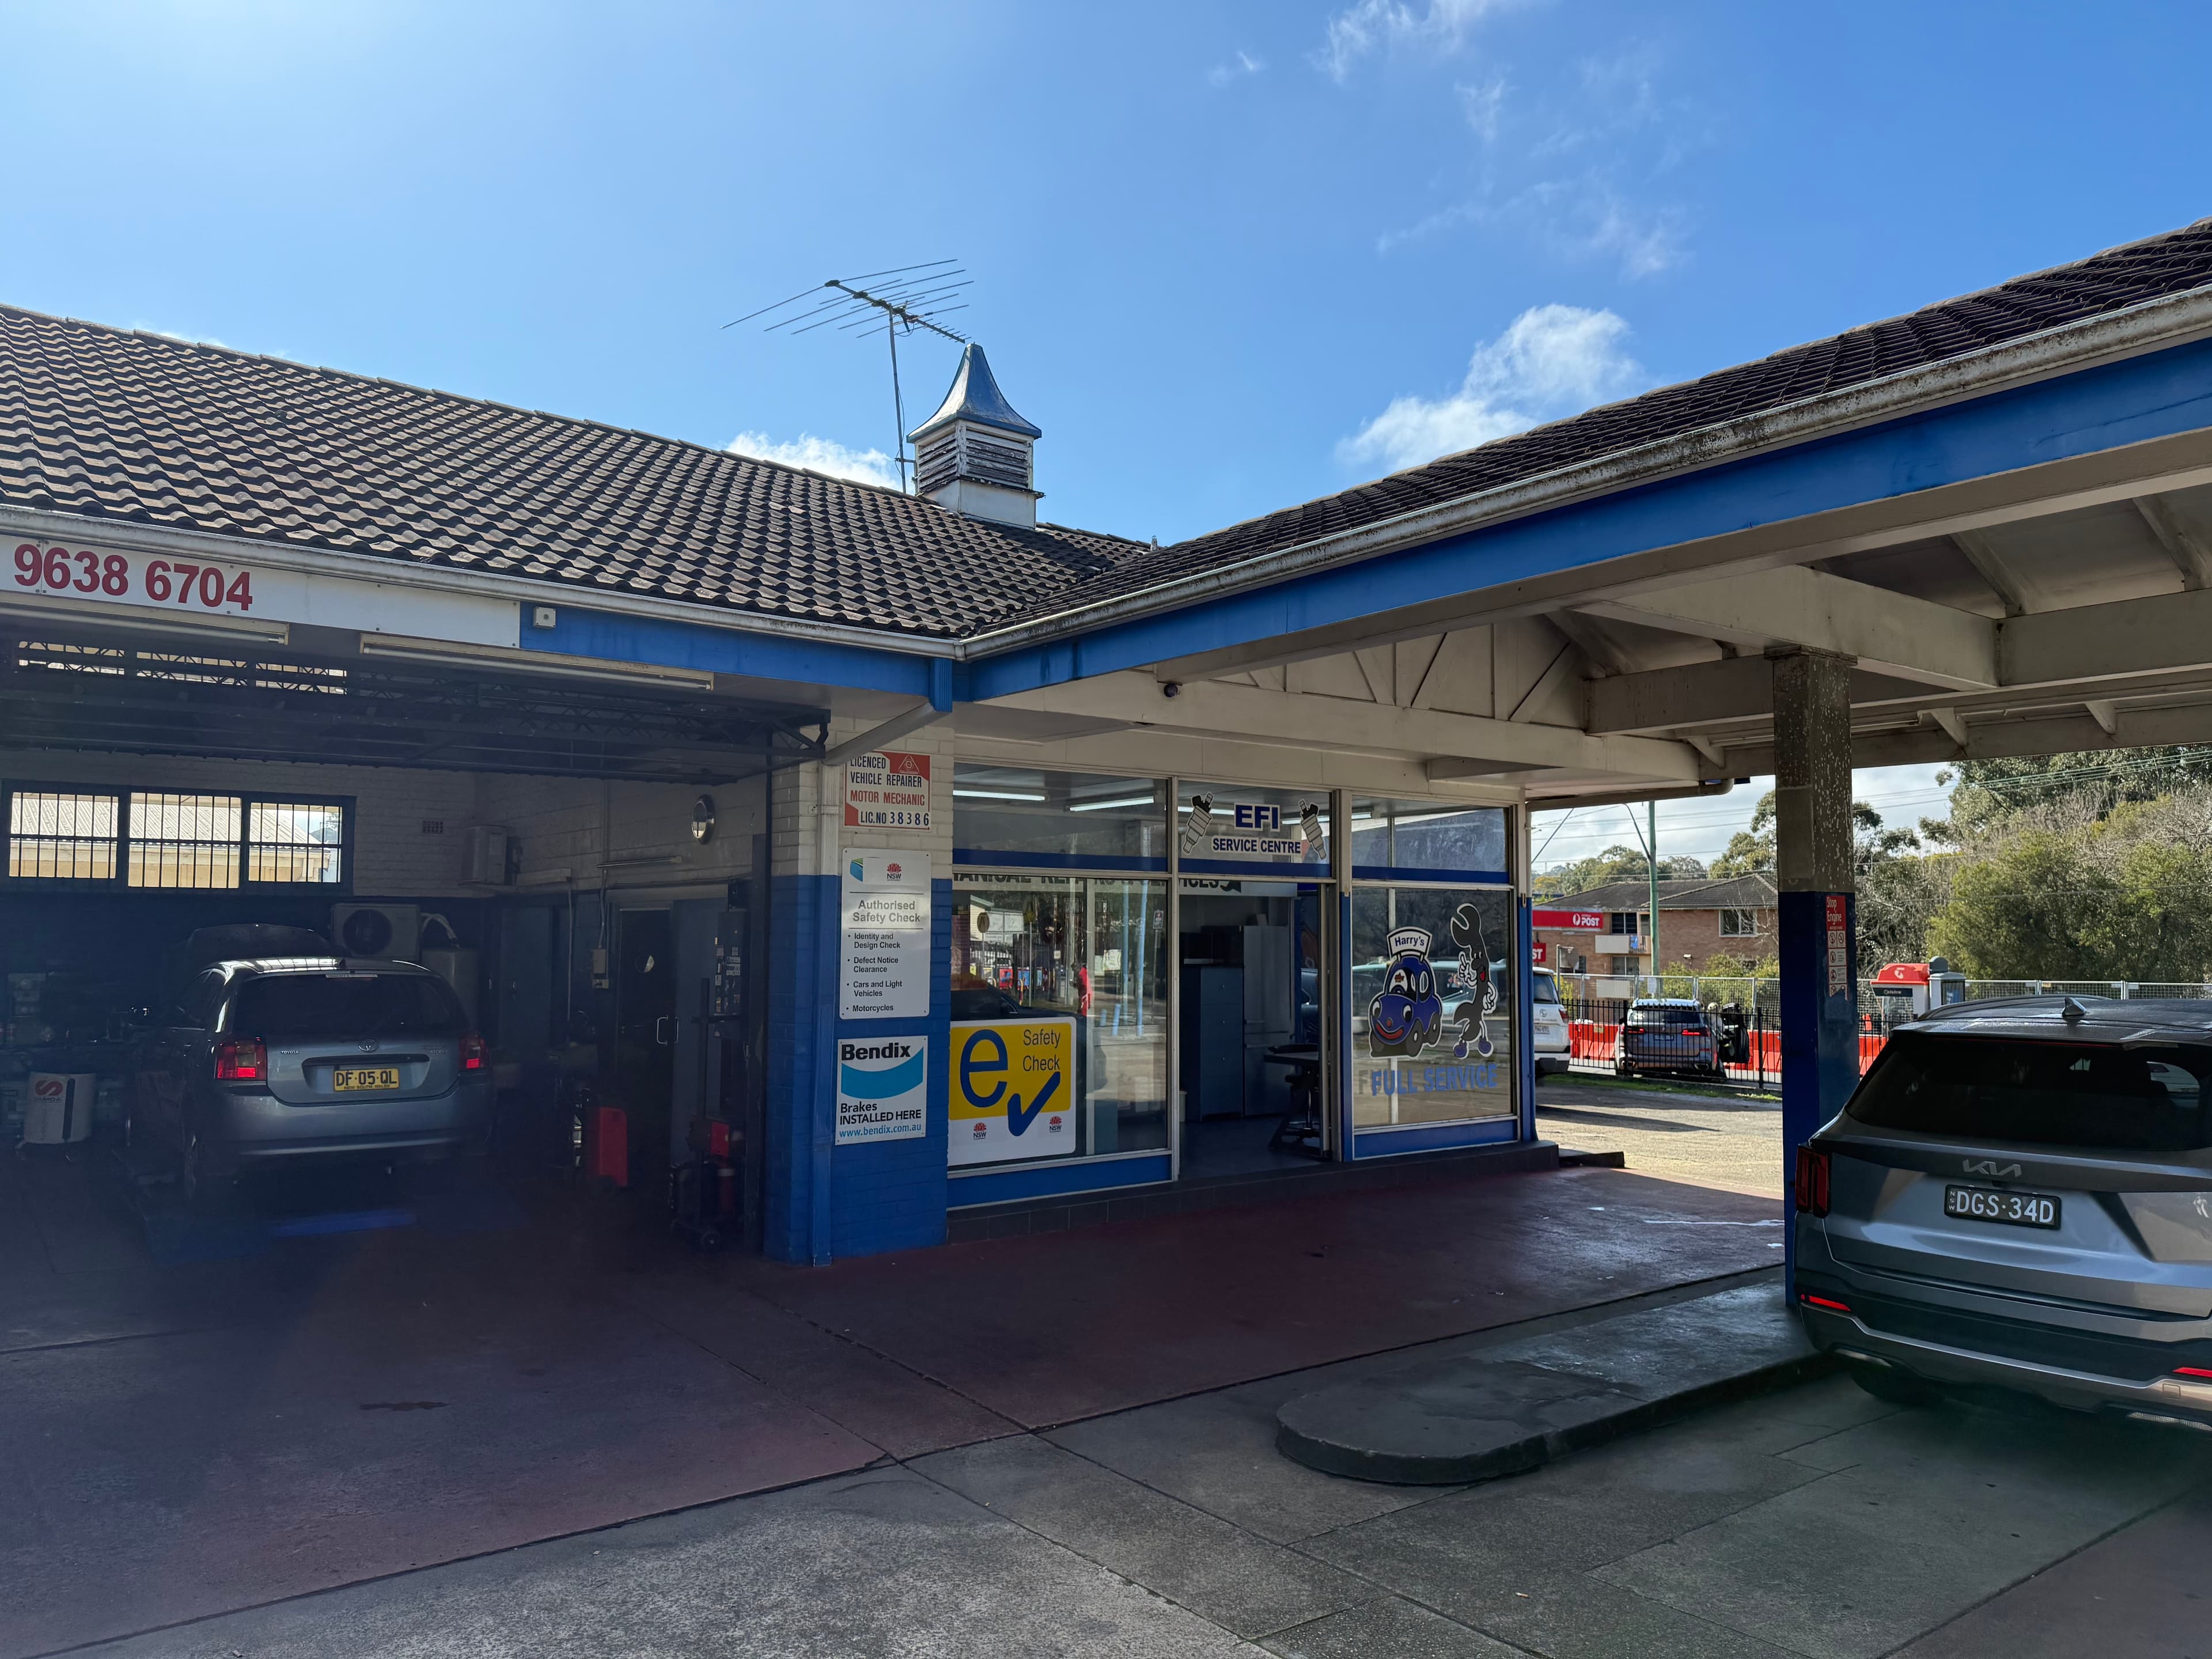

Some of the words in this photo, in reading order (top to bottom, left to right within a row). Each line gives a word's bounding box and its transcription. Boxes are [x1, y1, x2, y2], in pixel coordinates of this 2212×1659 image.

[14, 544, 128, 596] 9638
[145, 560, 252, 611] 6704
[850, 756, 886, 769] LICENCED
[851, 771, 882, 785] VEHICLE
[887, 774, 922, 787] REPAIRER
[850, 790, 879, 803] MOTOR
[884, 792, 925, 806] MECHANIC
[861, 811, 887, 824] LIC.NO
[1236, 805, 1278, 830] EFI
[1213, 838, 1257, 852] SERVICE
[1260, 840, 1301, 854] CENTRE
[858, 900, 915, 910] Authorised
[1827, 896, 1837, 911] Stop
[853, 912, 886, 924] Safety
[889, 912, 920, 922] Check
[1581, 917, 1600, 926] POST
[1827, 911, 1842, 925] Engine
[854, 933, 879, 941] Identity
[1395, 936, 1425, 946] Harry's
[854, 942, 878, 950] Design
[1532, 948, 1543, 960] ST
[885, 980, 902, 988] Light
[853, 1004, 893, 1013] Motorcycles
[1023, 1029, 1060, 1048] Safety
[841, 1042, 911, 1061] Bendix
[1022, 1054, 1060, 1071] Check
[1372, 1070, 1418, 1096] FULL
[1424, 1063, 1498, 1092] SERVICE
[840, 1101, 877, 1113] Brakes
[840, 1112, 893, 1125] INSTALLED
[896, 1109, 922, 1120] HERE
[839, 1124, 922, 1138] www.bendix.com.au
